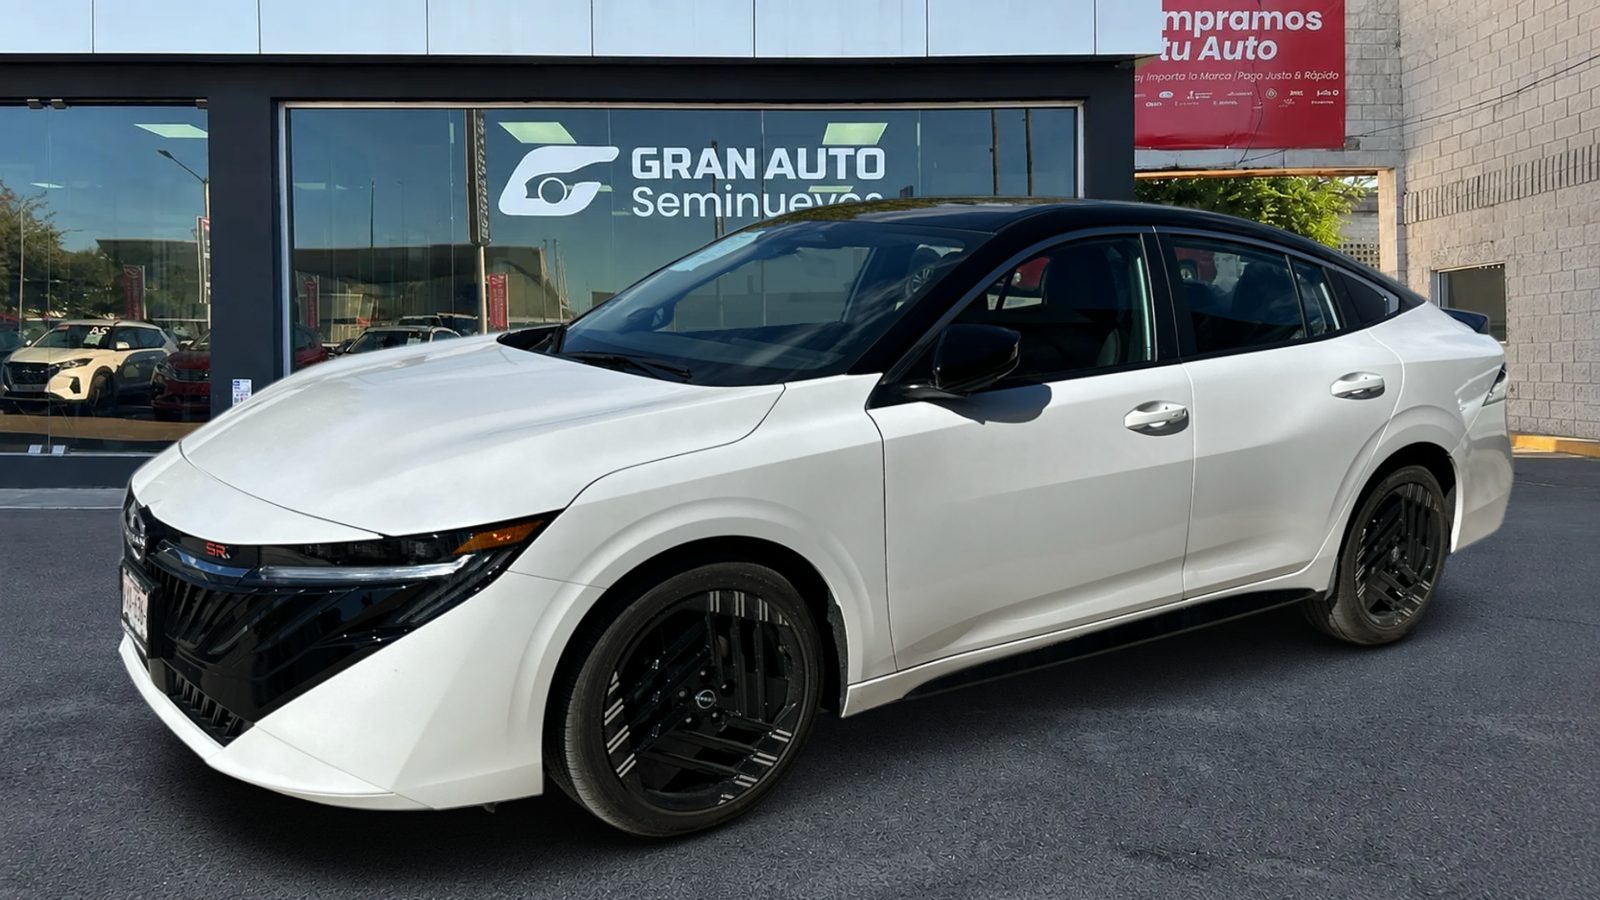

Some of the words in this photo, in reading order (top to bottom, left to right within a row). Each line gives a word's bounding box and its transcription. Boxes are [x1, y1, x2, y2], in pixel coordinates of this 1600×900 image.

[1160, 37, 1191, 61] tu
[1197, 36, 1278, 60] Auto
[1146, 72, 1186, 83] Importa
[1188, 71, 1198, 80] la
[1200, 71, 1232, 80] Marca
[1265, 71, 1292, 80] Justo
[1304, 70, 1339, 82] Rápido
[631, 147, 755, 180] GRAN
[763, 147, 886, 180] AUTO
[632, 184, 884, 218] Seminuev
